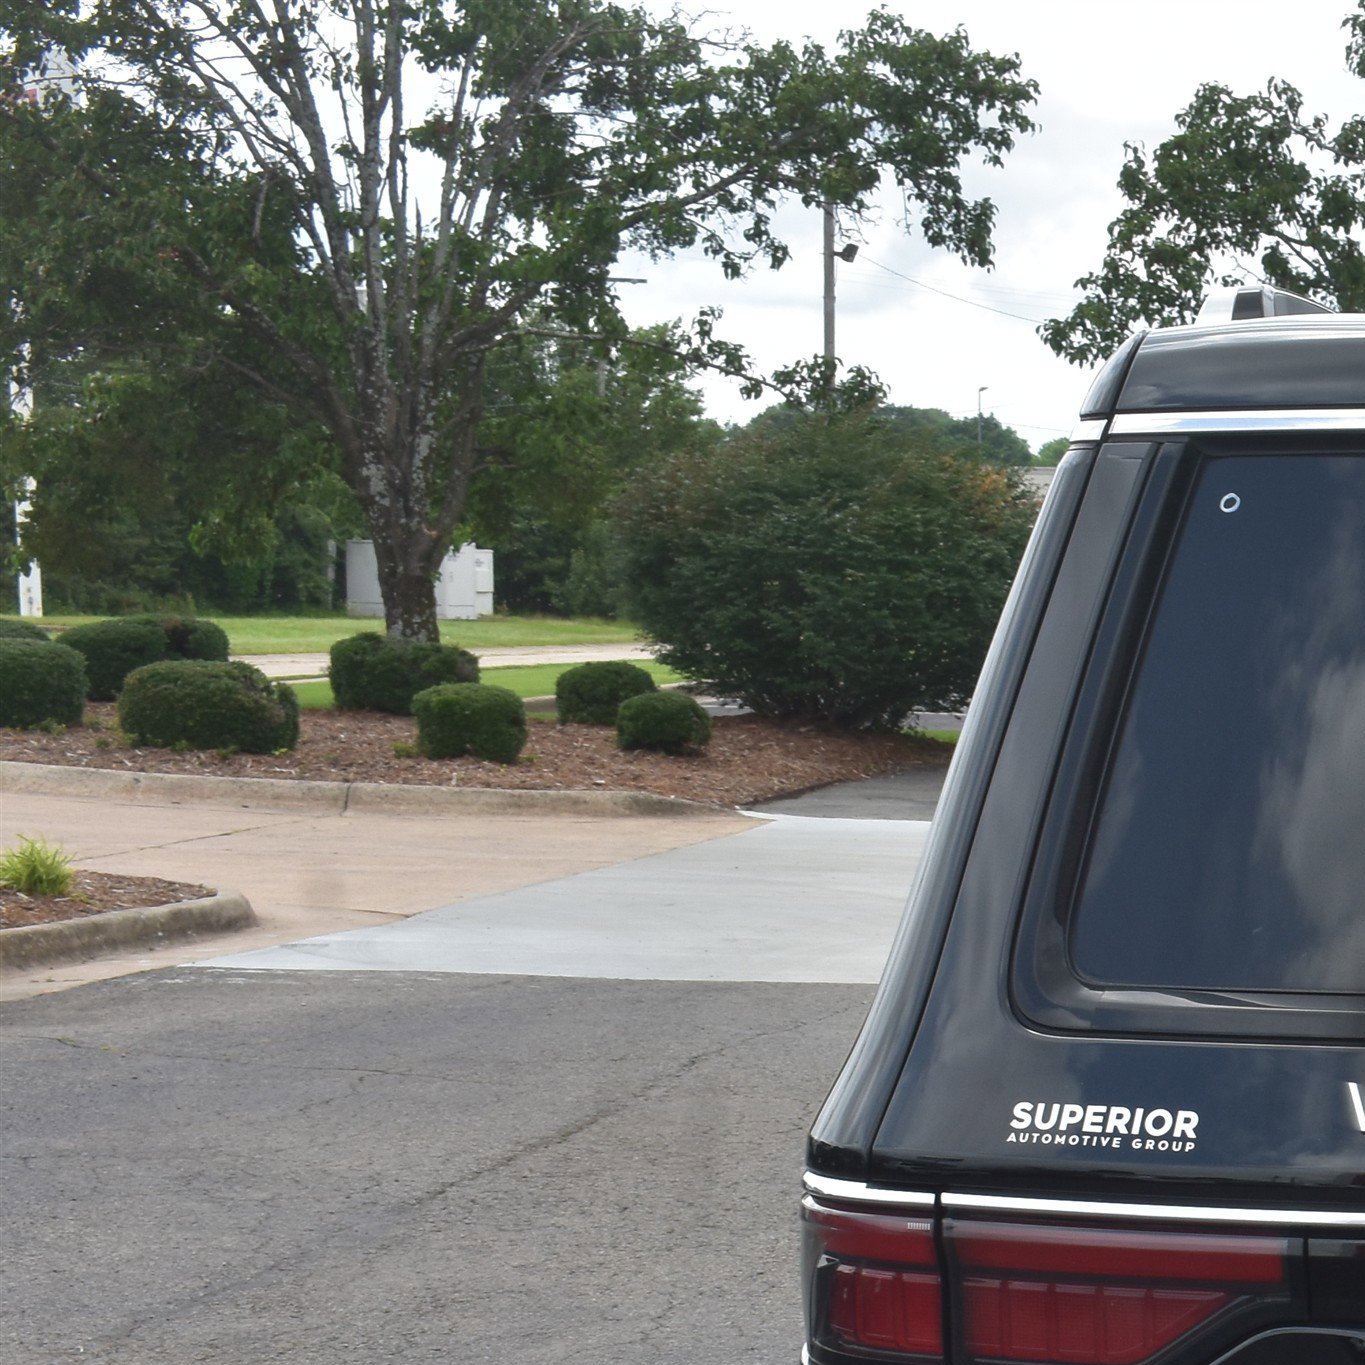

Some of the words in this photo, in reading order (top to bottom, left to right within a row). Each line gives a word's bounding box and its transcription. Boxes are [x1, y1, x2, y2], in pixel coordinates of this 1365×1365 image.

[1009, 1101, 1200, 1139] SUPERIOR
[1006, 1132, 1122, 1149] AUTOMOTIVE
[1131, 1138, 1196, 1153] GROUP
